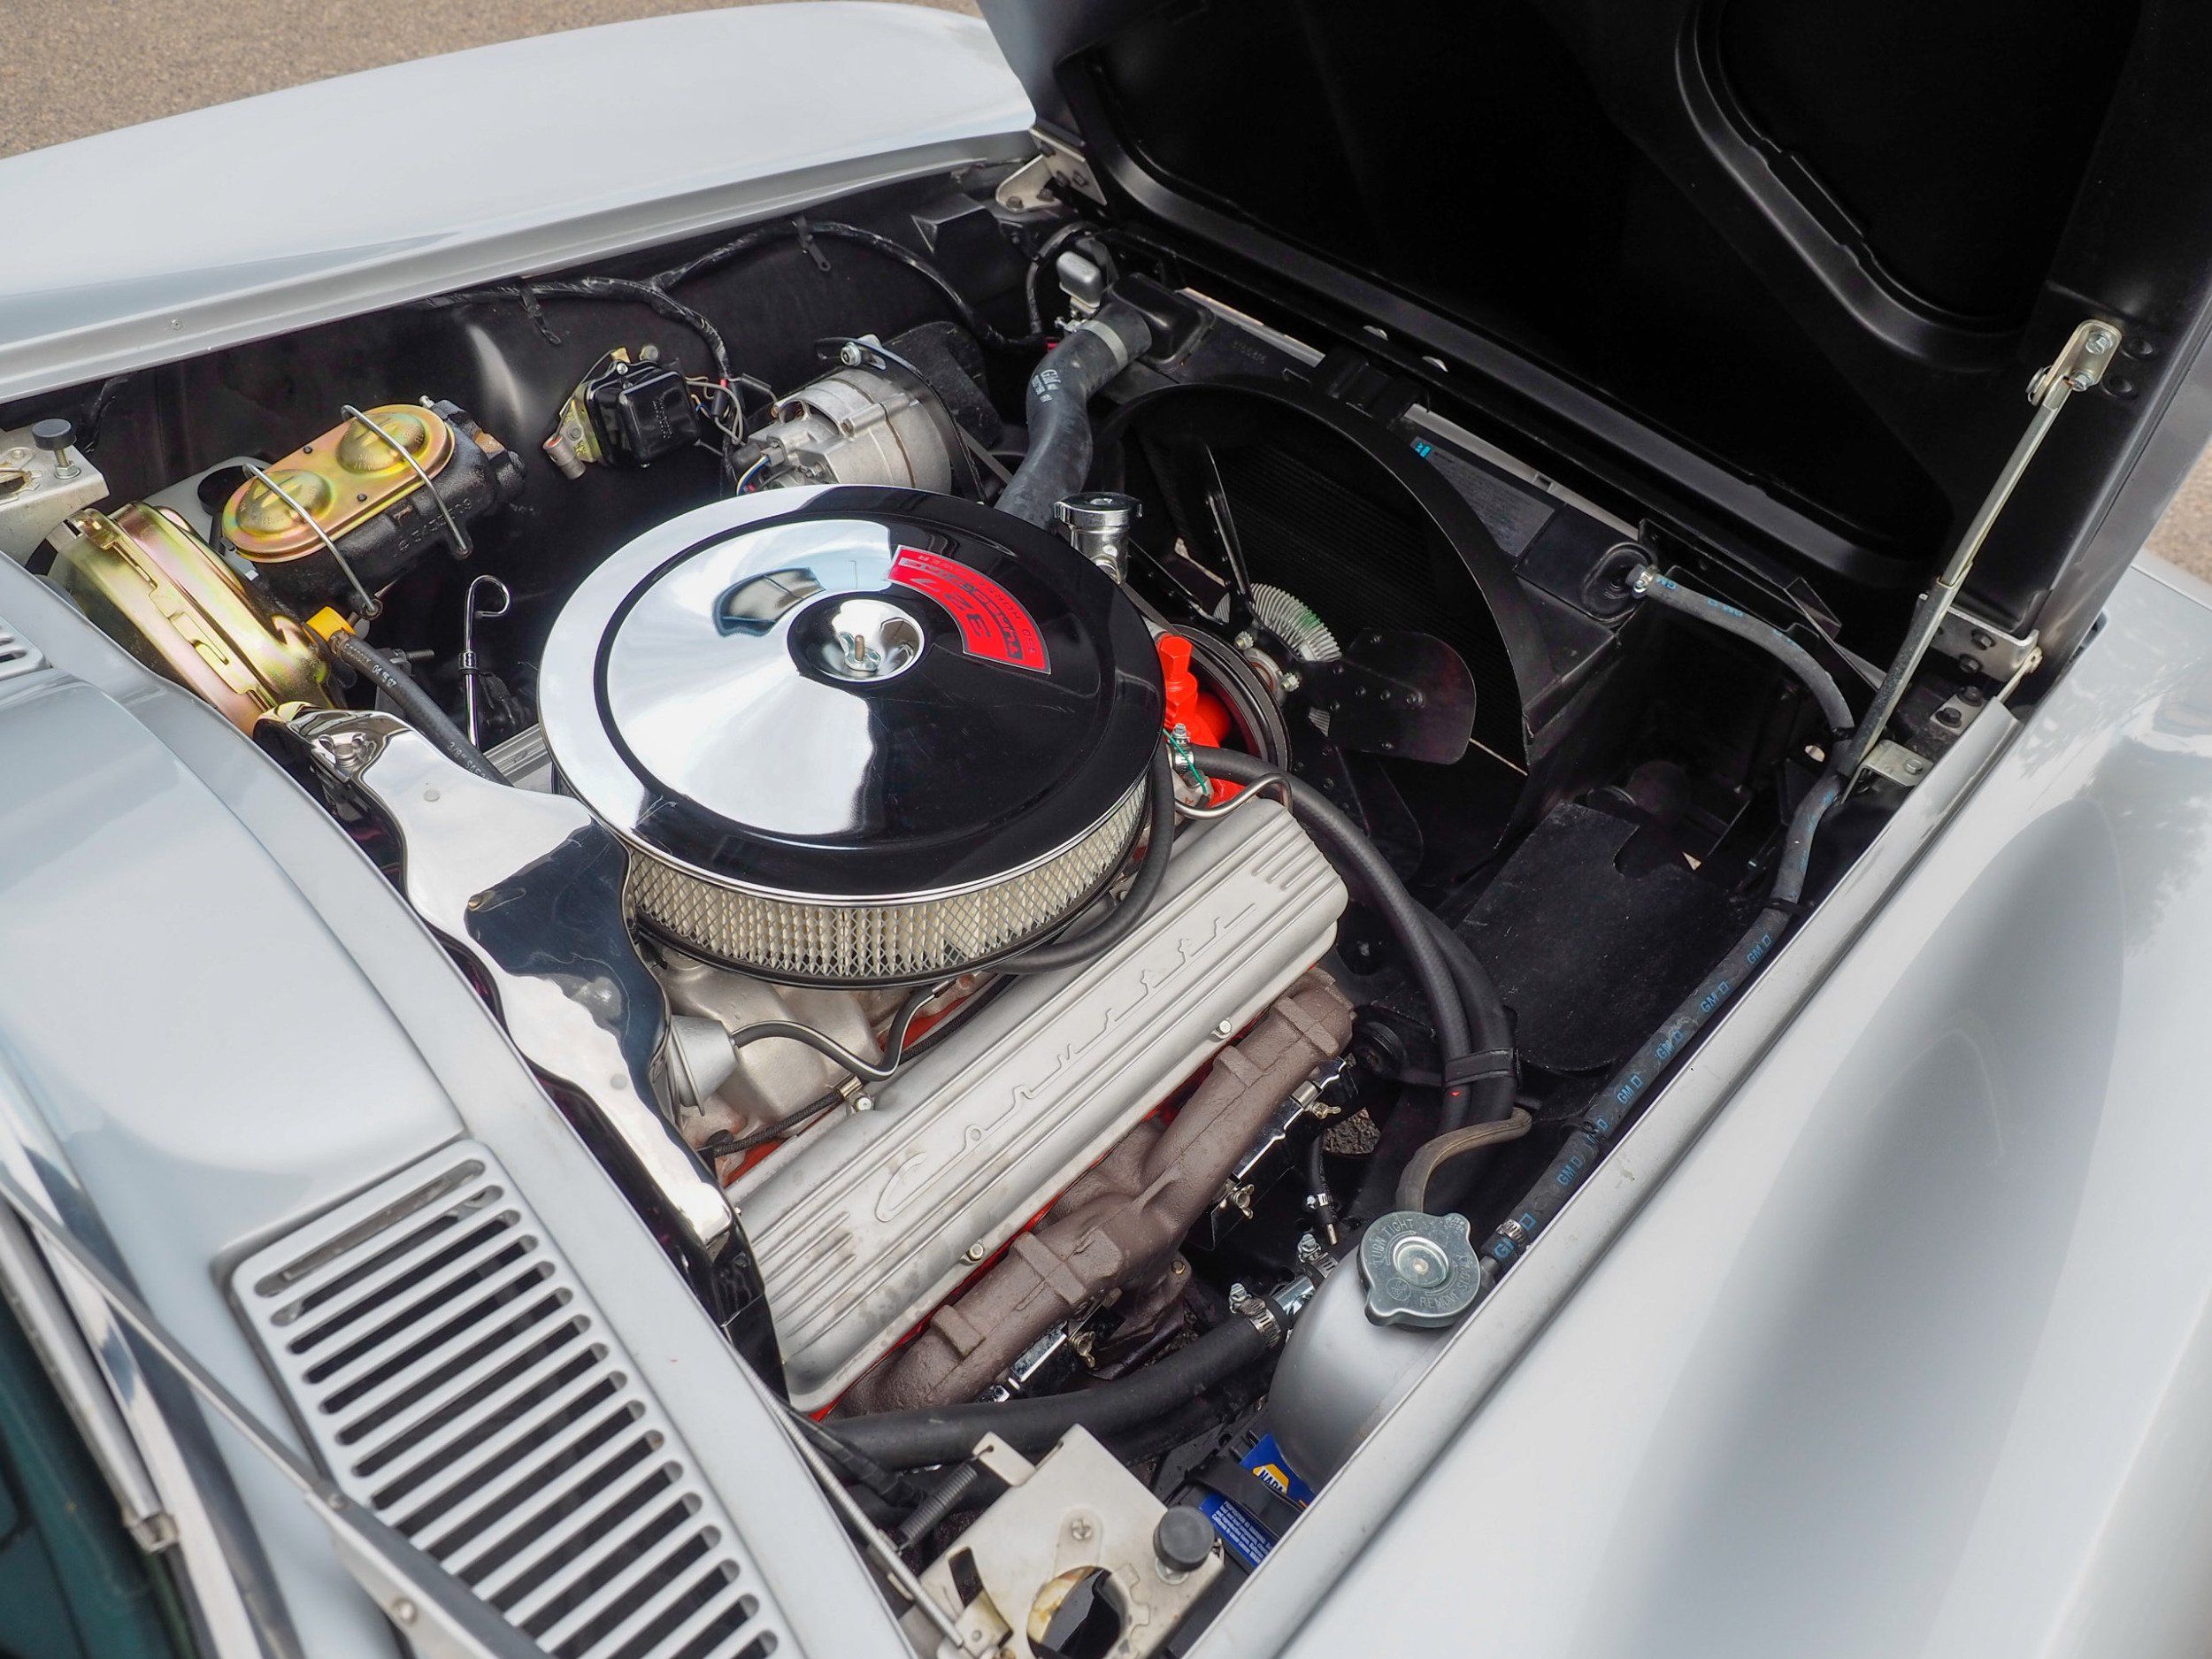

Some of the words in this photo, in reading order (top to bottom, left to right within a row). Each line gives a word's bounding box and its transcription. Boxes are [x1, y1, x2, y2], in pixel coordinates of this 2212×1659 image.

[910, 577, 991, 638] 327
[1700, 991, 1719, 1013] GM
[874, 902, 1256, 1223] Corvette
[1616, 1083, 1635, 1106] GM
[1555, 1164, 1574, 1187] GM
[1381, 1218, 1414, 1236] TIGHT
[1419, 1290, 1460, 1310] REMOVE
